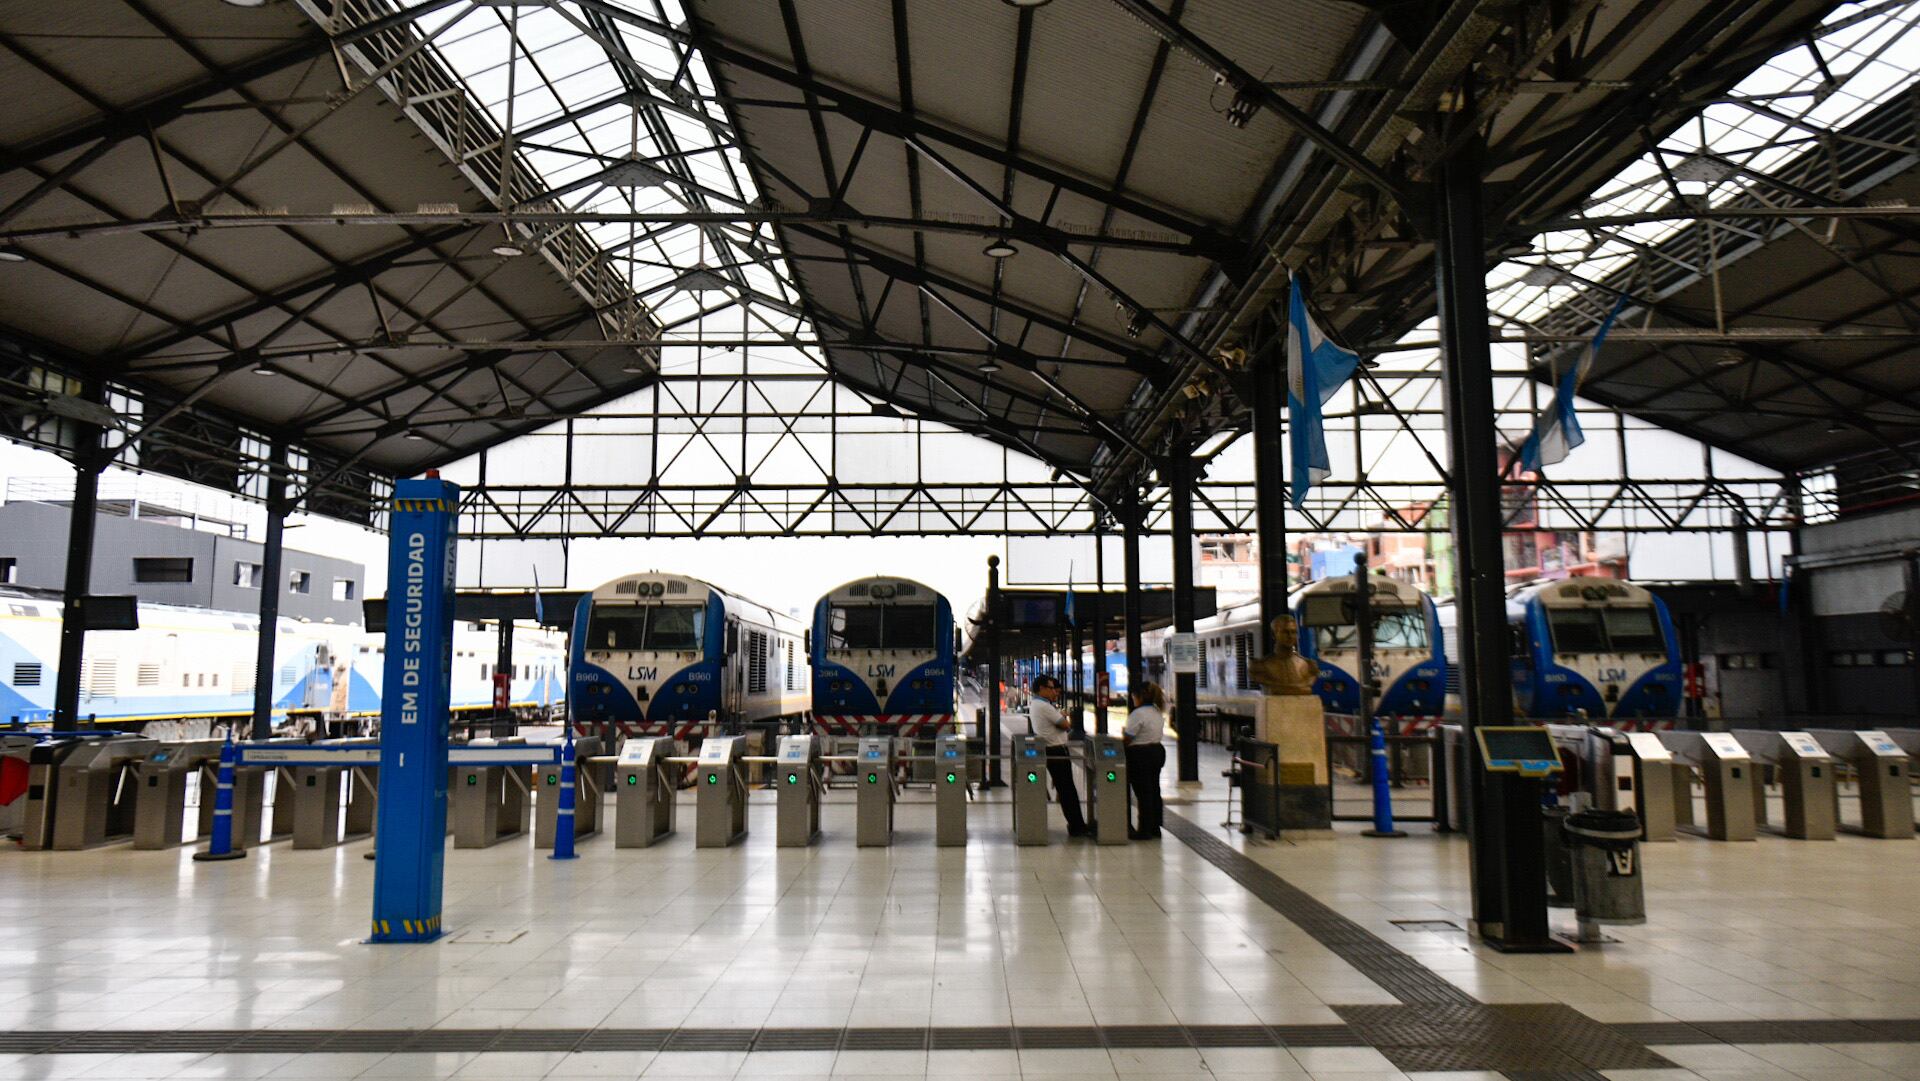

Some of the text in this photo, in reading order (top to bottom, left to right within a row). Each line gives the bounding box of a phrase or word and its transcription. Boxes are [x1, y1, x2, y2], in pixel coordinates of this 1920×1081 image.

[404, 532, 425, 653] SEGURIDAD
[403, 657, 420, 687] DE
[576, 672, 599, 681] B960
[628, 666, 657, 680] LSM
[688, 671, 711, 681] B960
[868, 664, 895, 677] LSM
[1598, 668, 1626, 682] LSM
